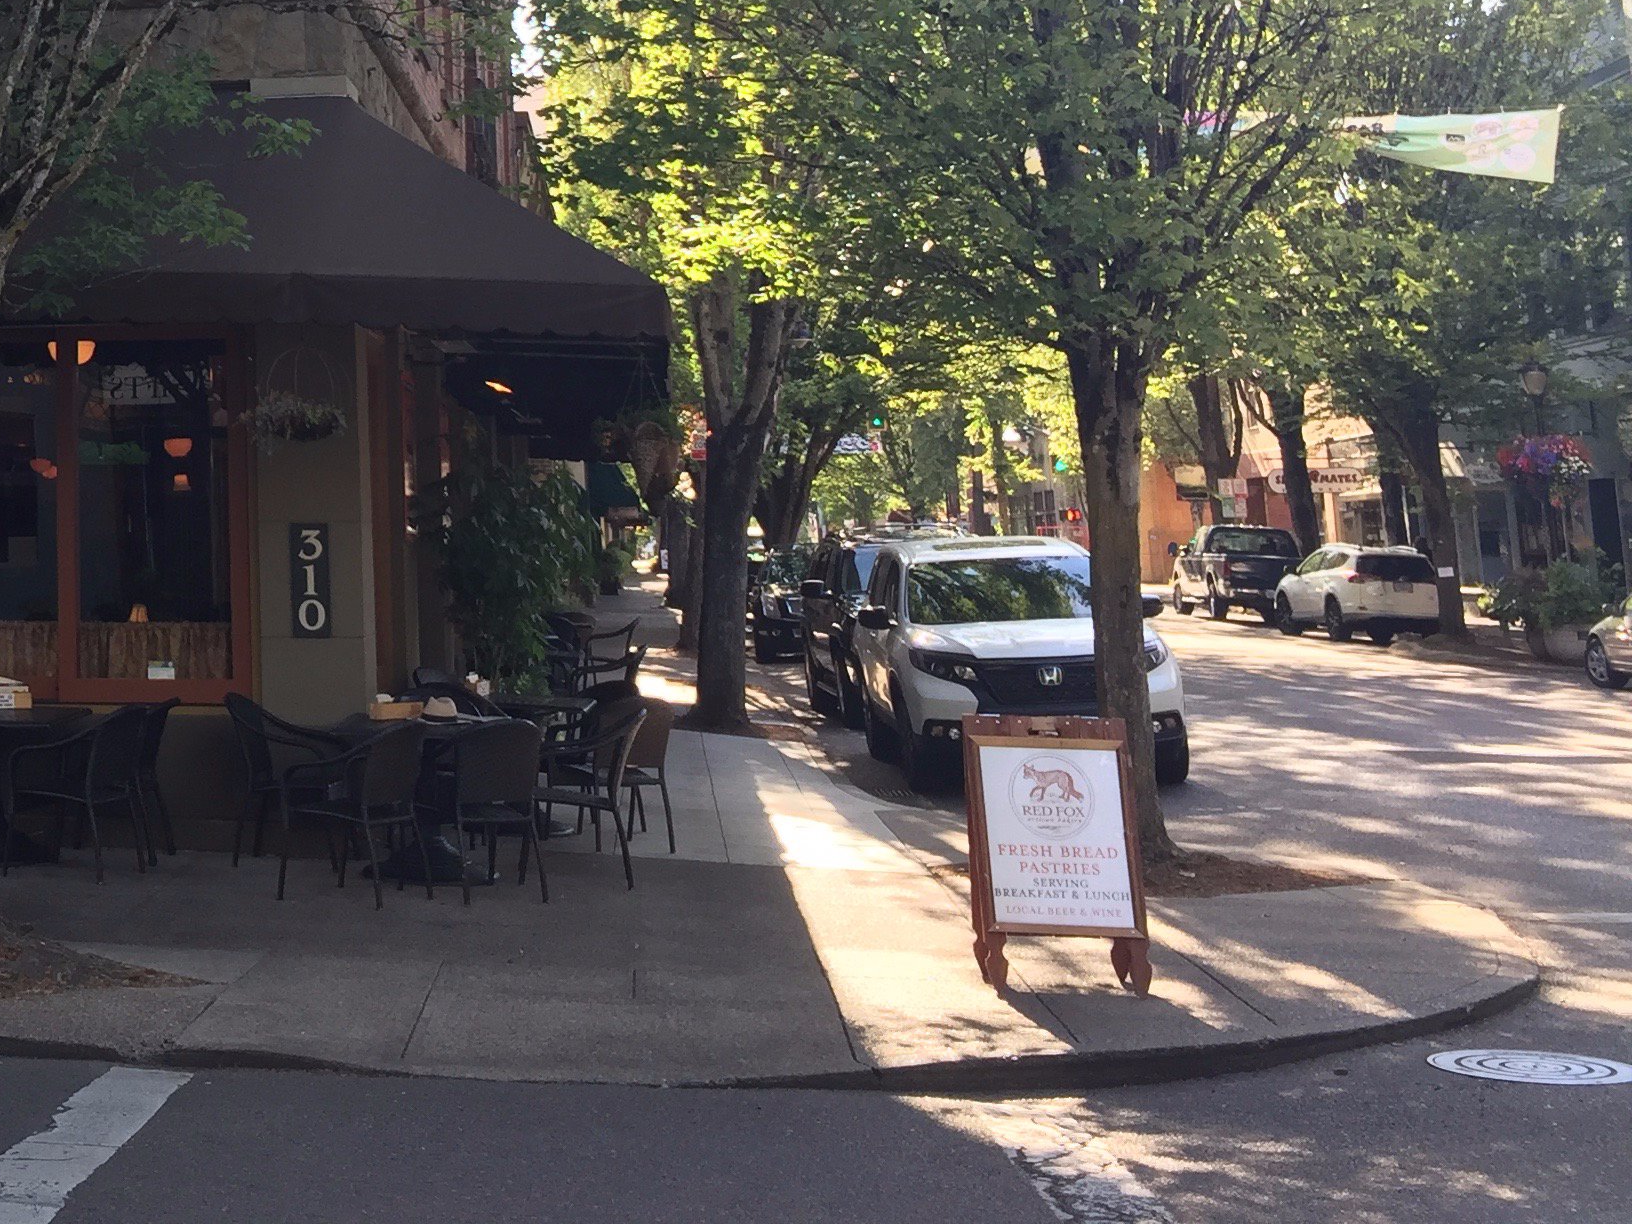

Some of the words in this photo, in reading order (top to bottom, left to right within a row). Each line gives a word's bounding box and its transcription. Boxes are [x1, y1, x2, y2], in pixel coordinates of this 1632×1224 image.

[298, 529, 326, 632] 310
[1022, 805, 1053, 817] RED
[1055, 806, 1086, 818] FOX
[997, 843, 1052, 858] FRESH
[1061, 845, 1119, 859] BREAD
[1019, 861, 1101, 876] PASTRIES
[1033, 877, 1089, 888] SERVING
[994, 887, 1066, 899] BREAKFAST
[1071, 890, 1080, 900] &
[1085, 890, 1130, 902] LUNCH
[1006, 905, 1044, 915] LOCAL
[1092, 907, 1123, 918] WINE
